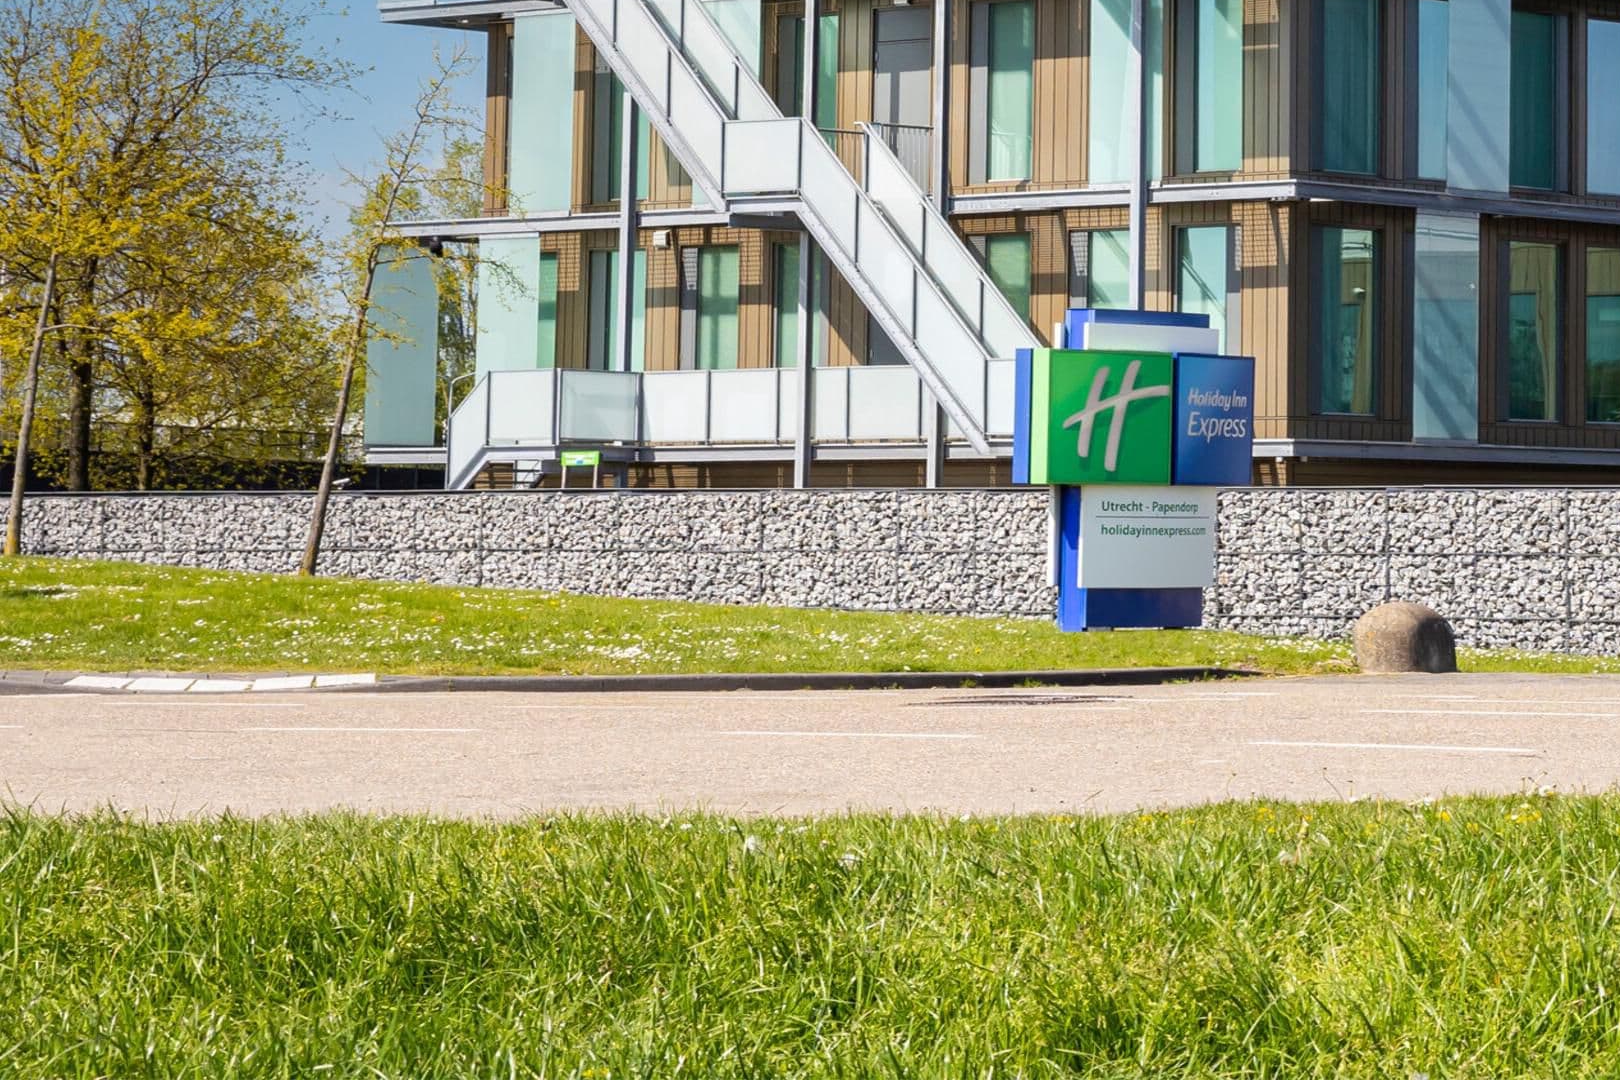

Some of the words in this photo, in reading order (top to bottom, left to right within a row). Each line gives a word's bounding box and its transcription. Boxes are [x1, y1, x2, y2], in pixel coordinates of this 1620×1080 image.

[1188, 387, 1231, 411] Holiday
[1232, 390, 1247, 408] Inn
[1063, 360, 1170, 472] H
[1187, 411, 1247, 443] Express
[1101, 501, 1143, 512] Utrecht
[1152, 501, 1199, 515] Papendorp
[1101, 524, 1206, 538] holidayinnexpress.com
